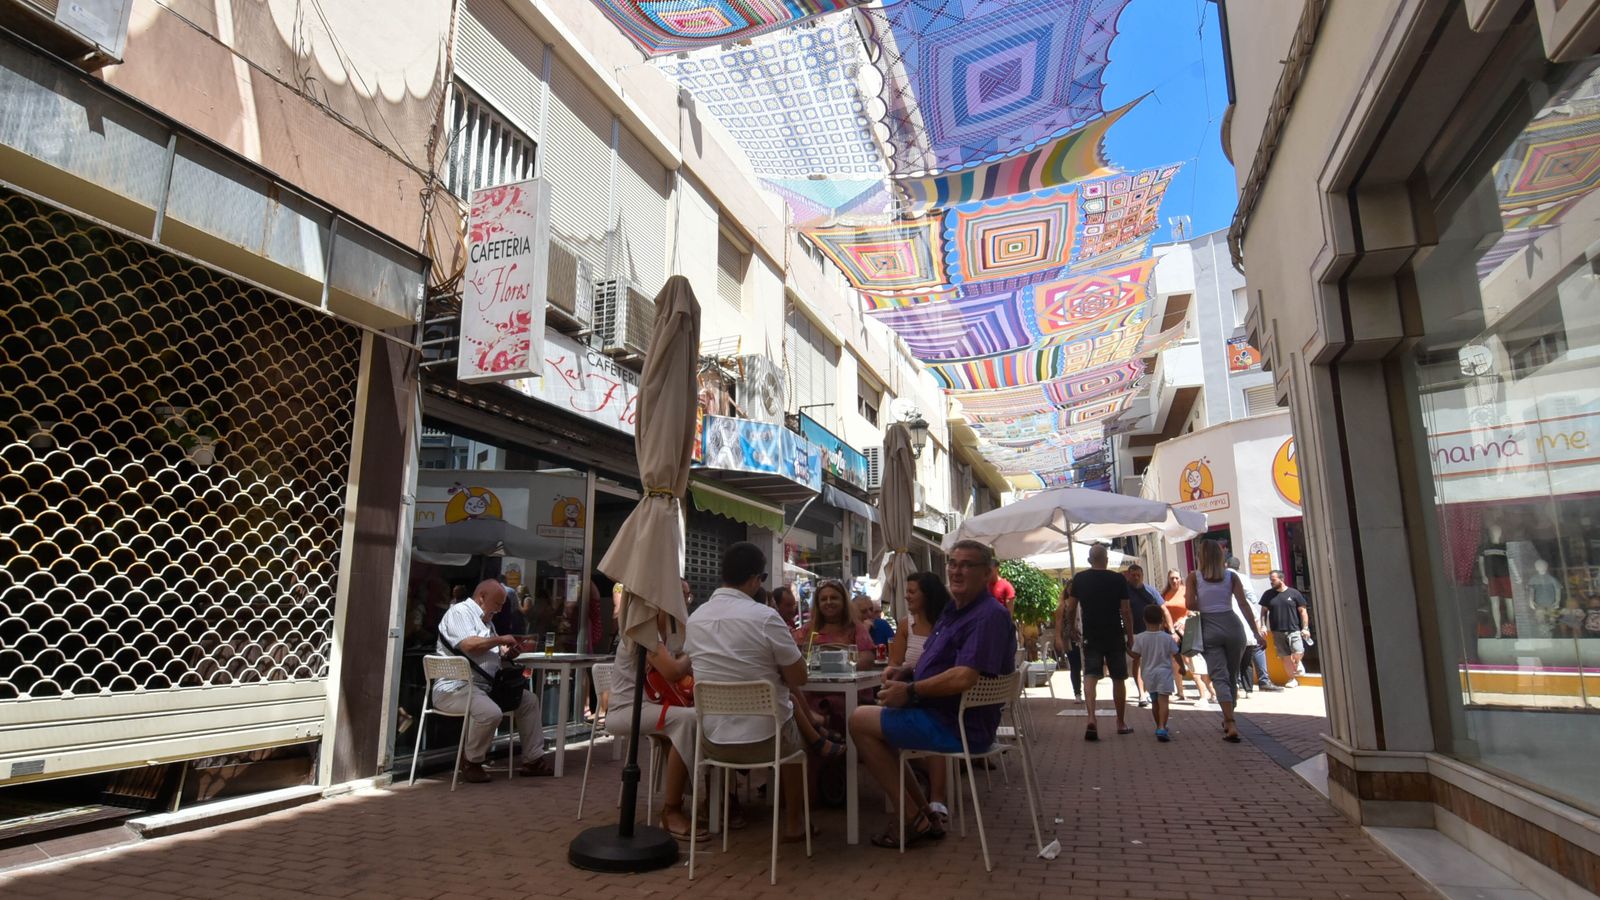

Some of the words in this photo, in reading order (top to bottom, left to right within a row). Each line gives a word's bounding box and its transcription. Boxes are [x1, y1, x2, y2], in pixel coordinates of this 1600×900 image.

[470, 235, 531, 263] CAFETERIA
[469, 269, 487, 295] Las
[478, 263, 530, 312] Flores
[586, 352, 640, 387] CAFETERI
[1535, 430, 1589, 454] me
